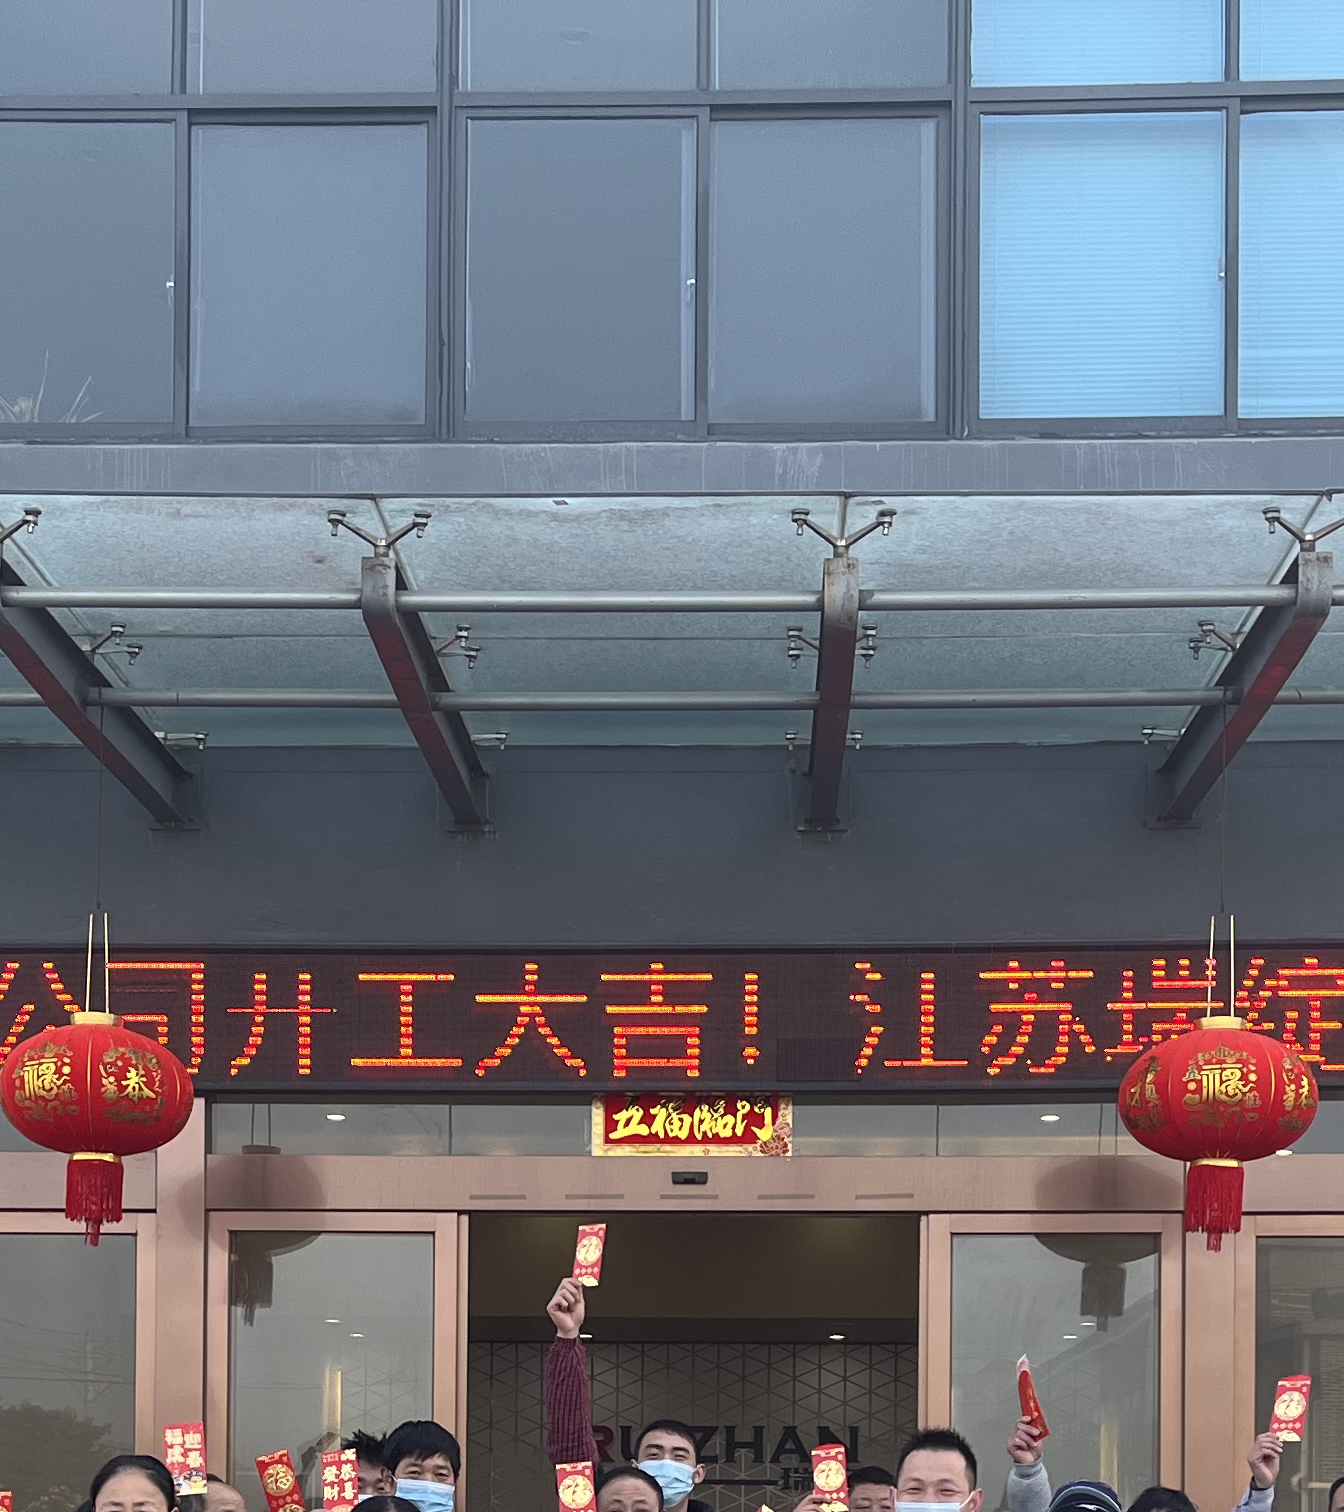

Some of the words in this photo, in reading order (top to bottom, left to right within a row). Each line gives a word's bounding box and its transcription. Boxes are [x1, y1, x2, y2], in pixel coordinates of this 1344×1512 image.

[23, 1056, 68, 1101] 福
[1199, 1062, 1254, 1106] 福
[592, 1425, 860, 1464] RUZHAN
